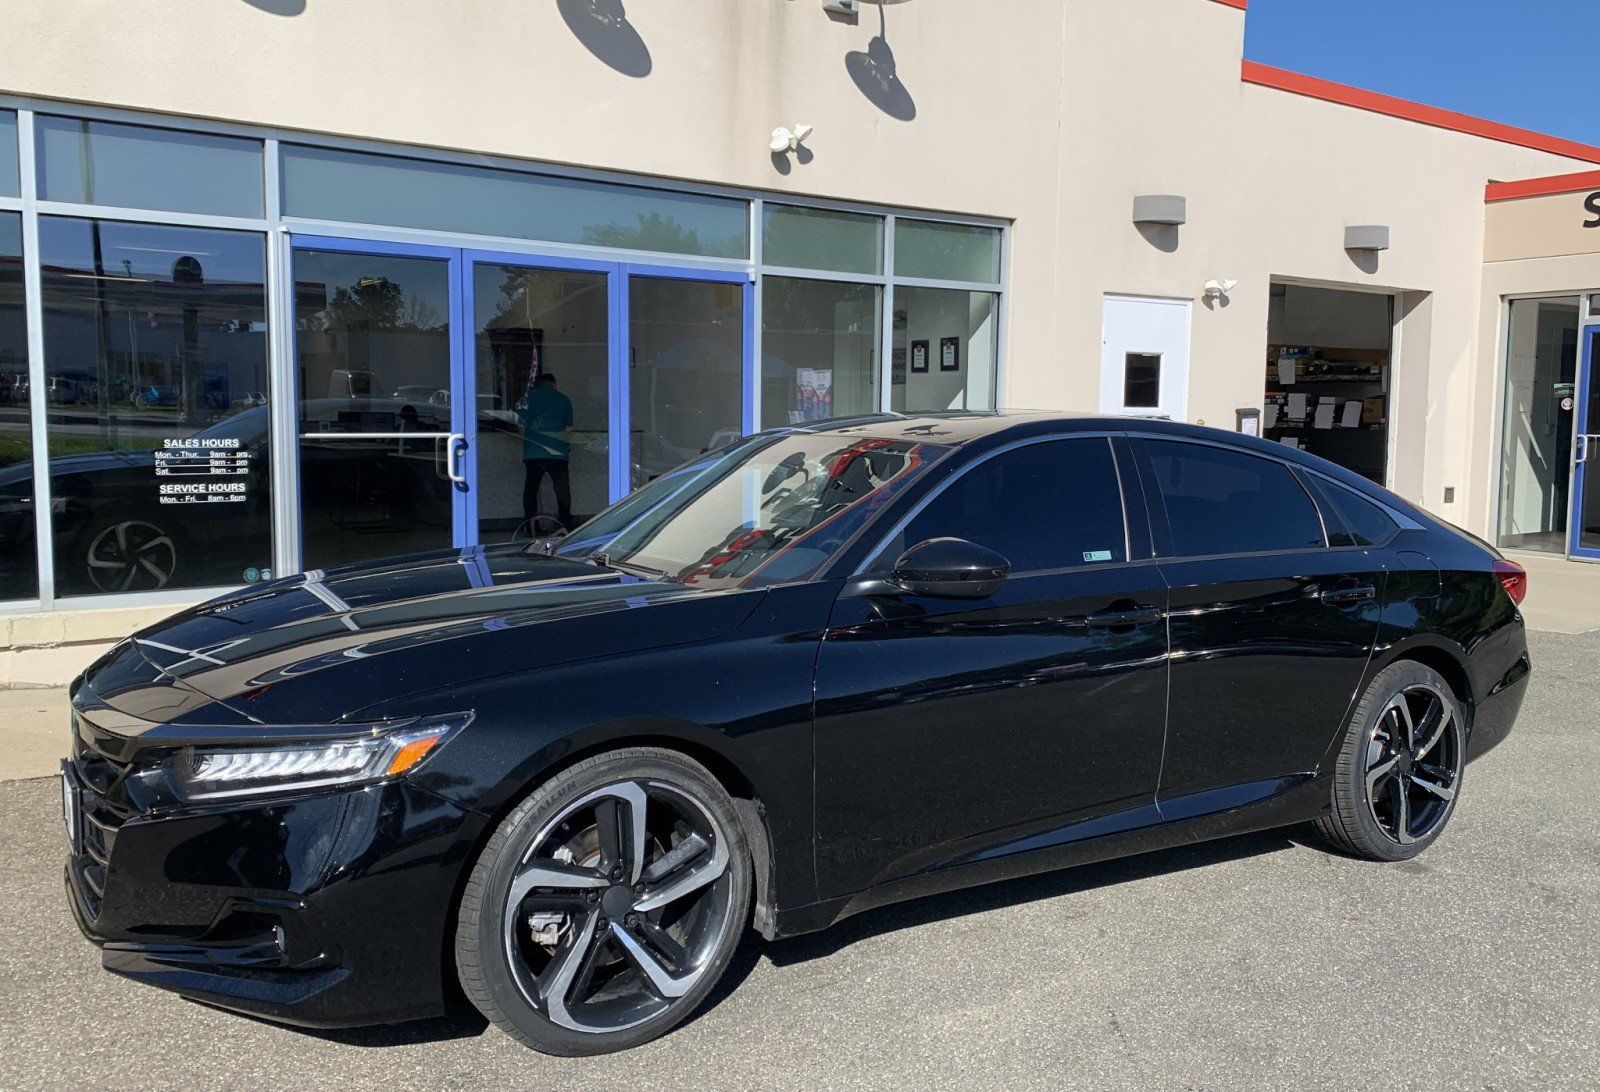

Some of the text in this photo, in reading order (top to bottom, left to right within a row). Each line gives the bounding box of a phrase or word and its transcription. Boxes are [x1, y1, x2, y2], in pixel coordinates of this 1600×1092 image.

[163, 438, 239, 448] SALES HOURS
[180, 450, 200, 458] Thur.
[155, 467, 171, 475] Sat.
[159, 483, 245, 494] SERVICE HOURS
[159, 496, 179, 504] Mon.
